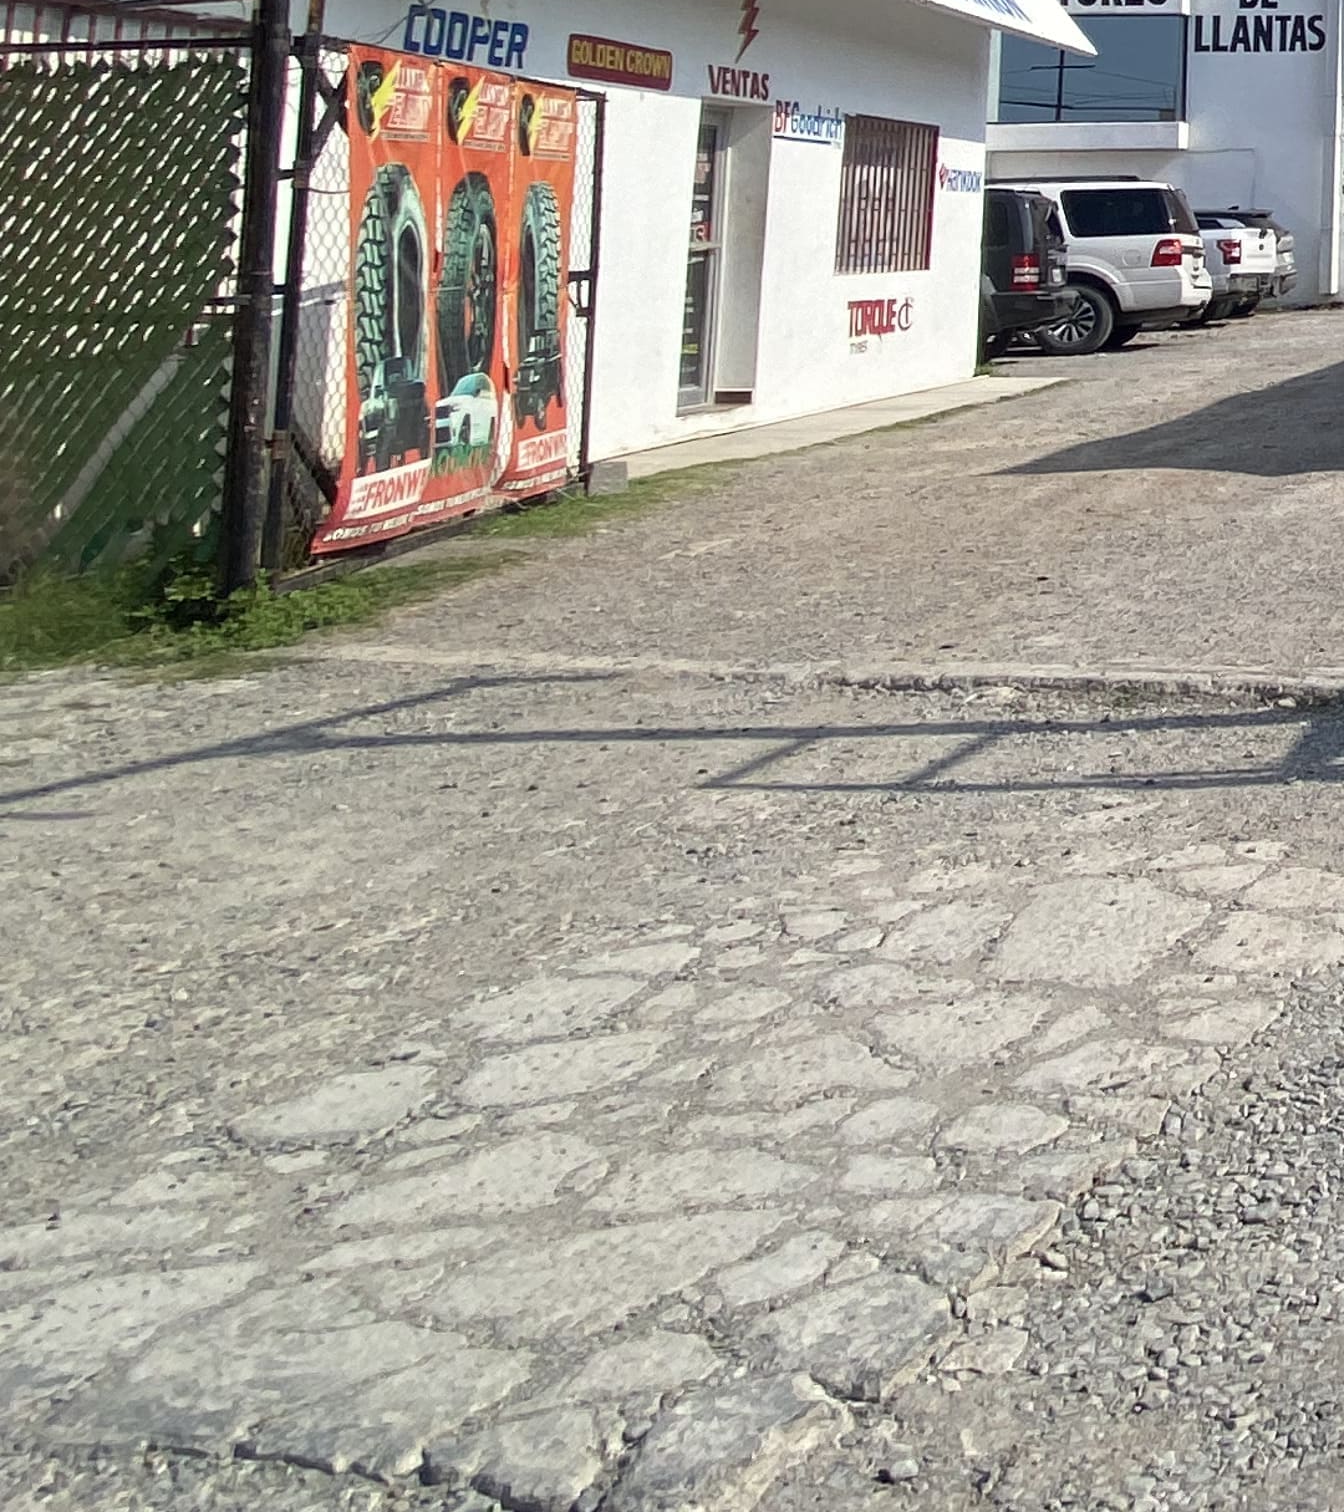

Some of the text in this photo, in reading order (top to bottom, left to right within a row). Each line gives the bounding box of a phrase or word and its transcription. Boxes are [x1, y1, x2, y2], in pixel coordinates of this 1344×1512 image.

[403, 4, 529, 70] COOPER
[1193, 14, 1327, 53] LLANTAS
[571, 39, 671, 80] GOLDEN CROWN
[708, 64, 770, 101] VENTAS
[847, 298, 898, 338] TORQUE
